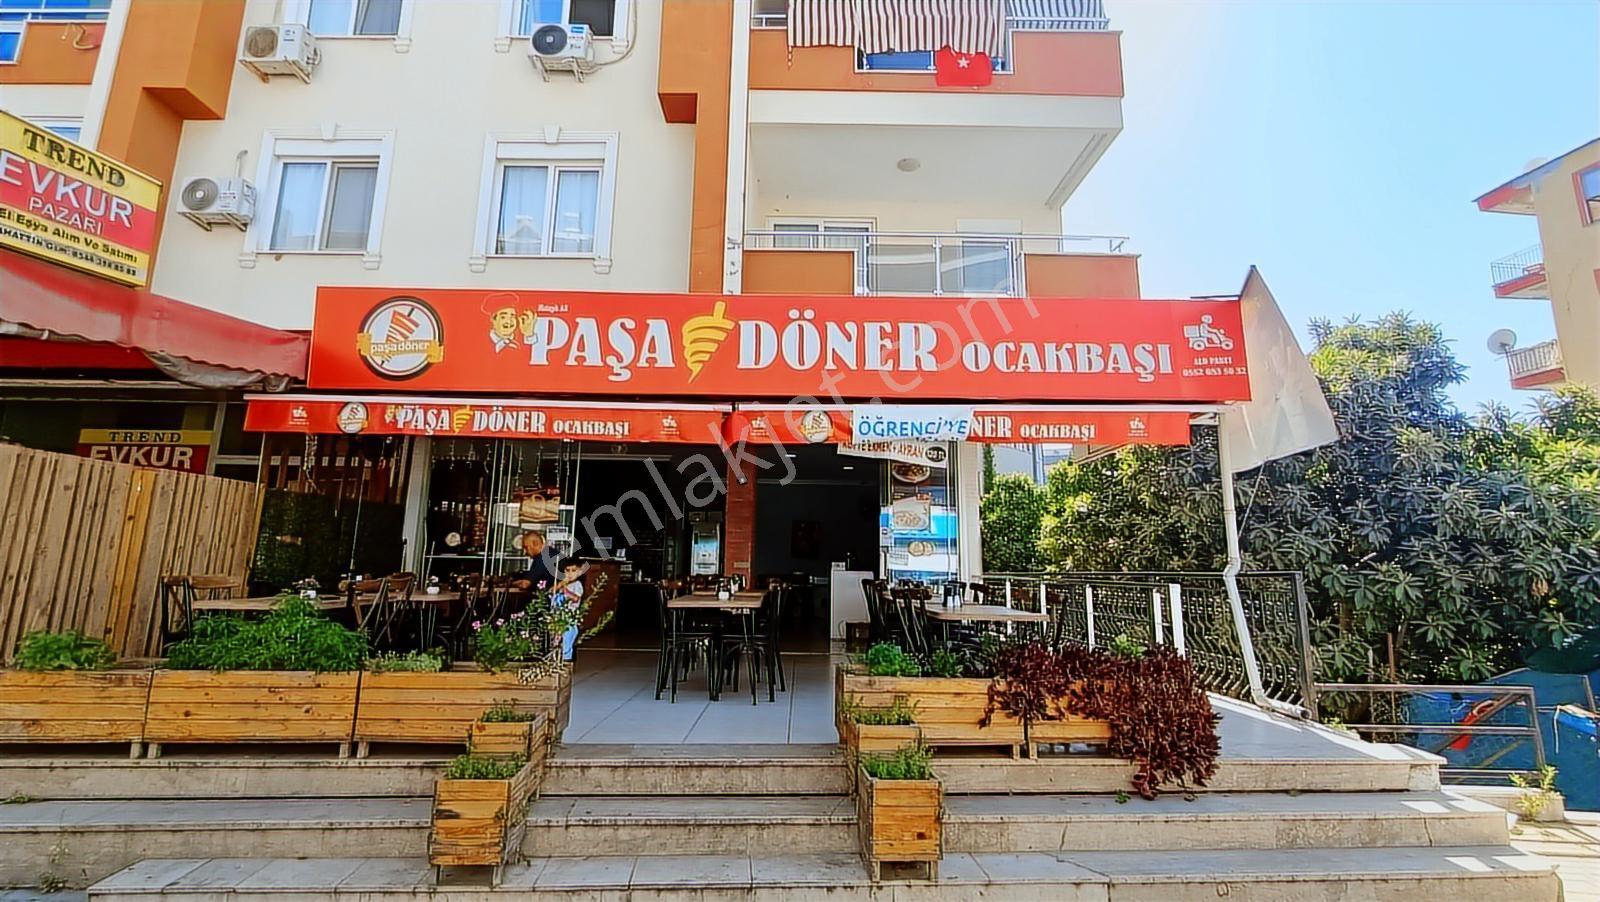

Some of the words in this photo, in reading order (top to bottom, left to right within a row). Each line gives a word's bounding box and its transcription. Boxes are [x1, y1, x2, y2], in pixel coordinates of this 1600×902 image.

[23, 128, 125, 188] TREND
[0, 151, 133, 228] EVKUR
[16, 213, 48, 232] Eşya
[52, 227, 80, 244] Alım
[29, 197, 102, 235] PAZARI
[529, 316, 675, 382] PAŞA
[736, 308, 938, 372] DÖNER
[962, 341, 1174, 383] OCAKBAŞI
[109, 431, 182, 443] TREND
[397, 408, 450, 435] PAŞA
[471, 406, 546, 433] DÖNER
[552, 418, 629, 438] OCAKBAŞI
[970, 415, 1012, 437] NER
[1020, 424, 1096, 441] OCAKBAŞI
[90, 445, 193, 469] EVKUR
